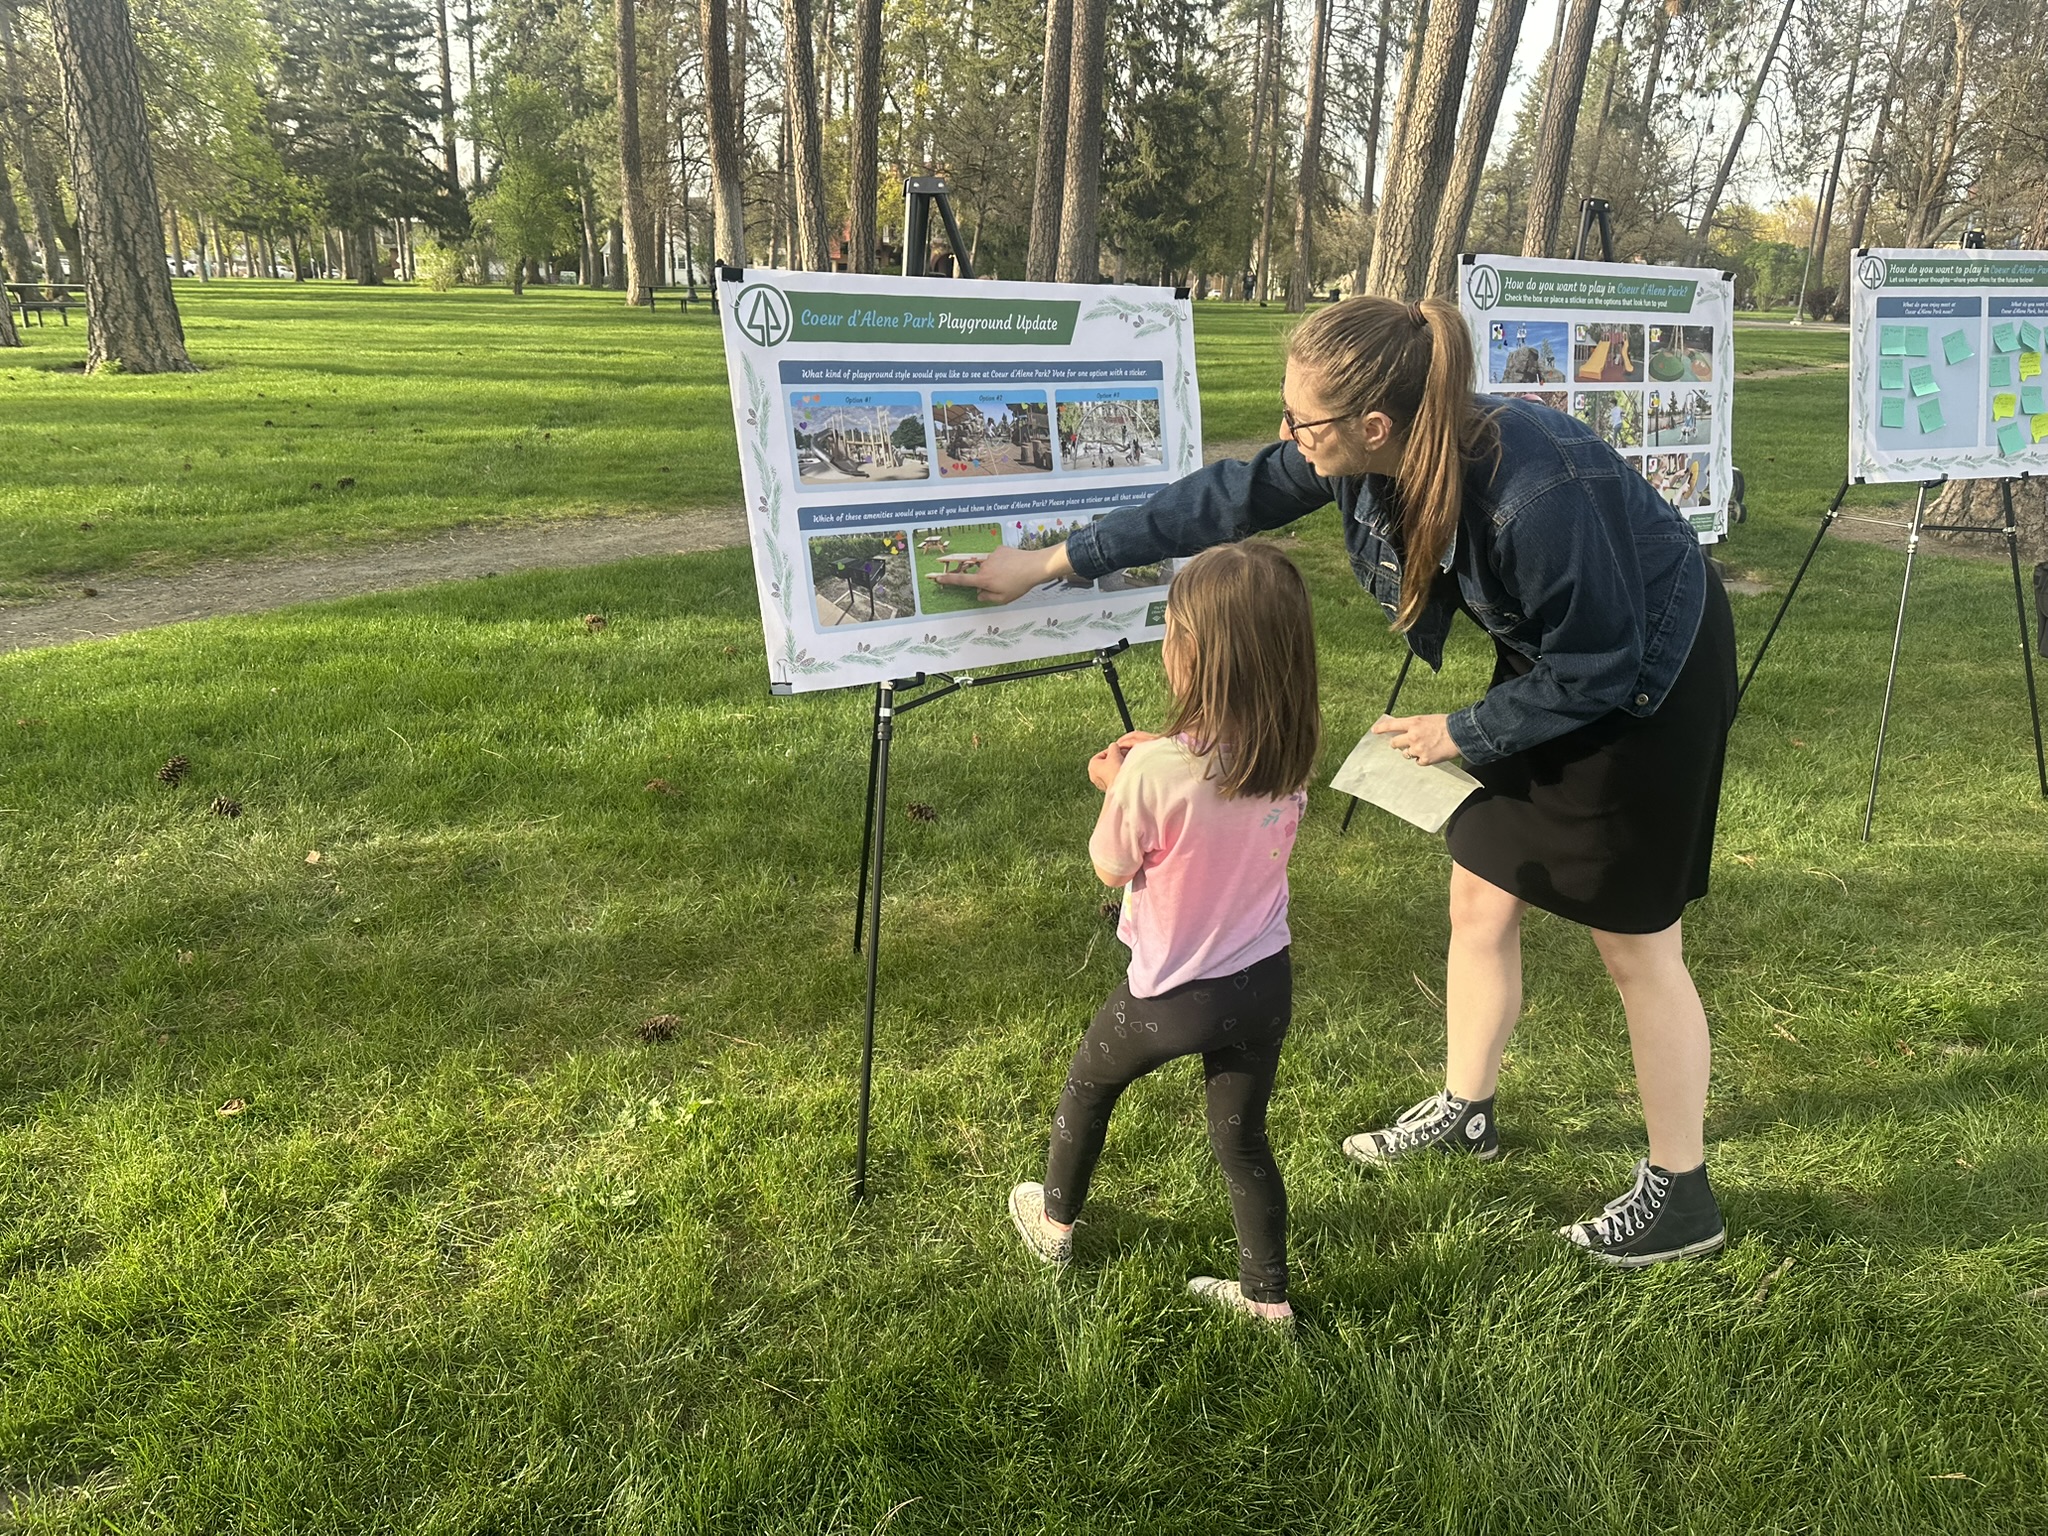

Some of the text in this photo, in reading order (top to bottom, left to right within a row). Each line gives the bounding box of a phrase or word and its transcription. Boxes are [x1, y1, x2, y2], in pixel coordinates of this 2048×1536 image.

[1889, 264, 2048, 277] How do you want to play in Coeur d'Alene Par
[1504, 277, 1689, 297] How do you want to play in Coeur d'Alene Park?
[1504, 293, 1522, 302] Check
[1523, 294, 1532, 302] the
[1532, 294, 1542, 302] box
[1550, 295, 1564, 304] place
[1569, 296, 1586, 304] sticker
[1603, 298, 1621, 307] options
[1643, 299, 1651, 307] fun
[1657, 300, 1668, 309] you!
[801, 309, 1058, 335] Coeur d'Alene Park Playground Update
[802, 369, 823, 379] What
[825, 369, 841, 379] kind
[843, 369, 851, 380] of
[852, 369, 893, 381] playground
[894, 369, 910, 381] style
[912, 369, 933, 378] would
[934, 371, 947, 380] you
[948, 369, 960, 378] like
[962, 370, 969, 378] to
[982, 370, 990, 378] at
[990, 369, 1008, 378] Coeur
[1010, 369, 1033, 378] d'Alene
[1034, 369, 1051, 378] Park?
[1052, 369, 1065, 378] Vote
[1066, 369, 1076, 378] for
[1089, 369, 1108, 379] option
[1109, 368, 1122, 376] with
[1129, 368, 1148, 376] sticker.
[845, 396, 863, 404] Option
[979, 395, 995, 403] Option
[1096, 392, 1112, 400] Option
[813, 514, 834, 523] Which
[836, 513, 844, 522] of
[845, 513, 862, 521] these
[862, 511, 893, 520] amenities
[894, 509, 914, 518] would
[914, 510, 926, 518] you
[939, 506, 945, 516] if
[945, 508, 957, 516] you
[958, 505, 969, 513] had
[970, 504, 985, 513] them
[993, 503, 1009, 511] Coeur
[1010, 501, 1031, 509] d'Alene
[1031, 499, 1048, 508] Park?
[1048, 498, 1065, 506] Please
[1065, 498, 1080, 507] place
[1085, 496, 1102, 504] sticker
